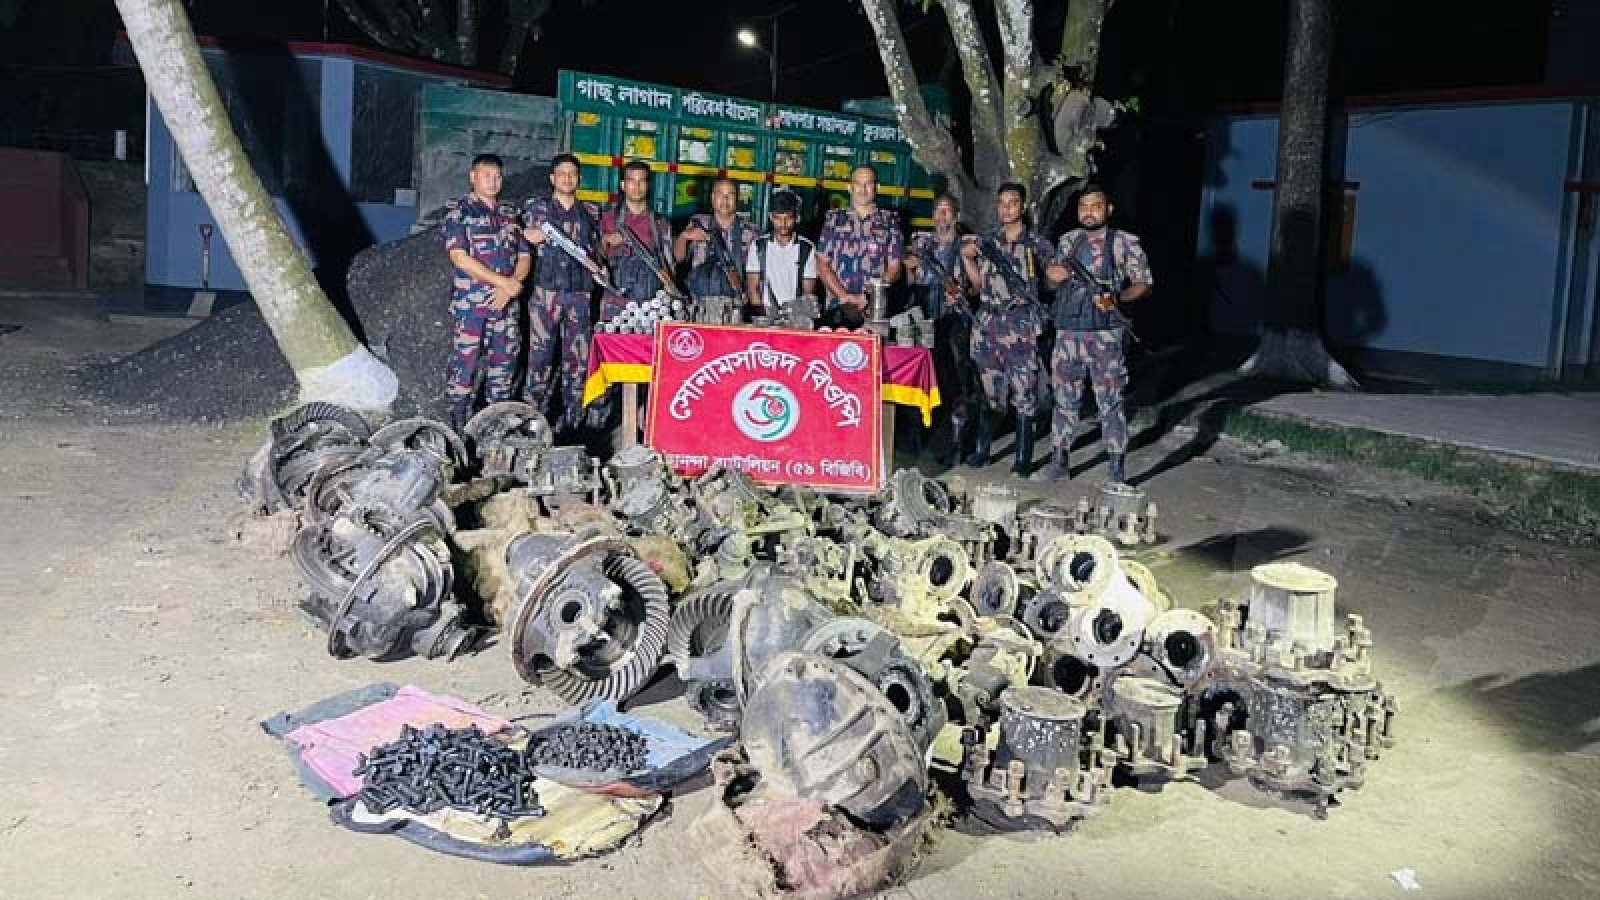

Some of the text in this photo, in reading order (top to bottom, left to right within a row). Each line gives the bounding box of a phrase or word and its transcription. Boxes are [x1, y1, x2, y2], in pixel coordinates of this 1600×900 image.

[577, 80, 616, 107] গাছ
[618, 86, 672, 110] লাগান
[670, 341, 861, 429] সোনামসজিদ বিওপি
